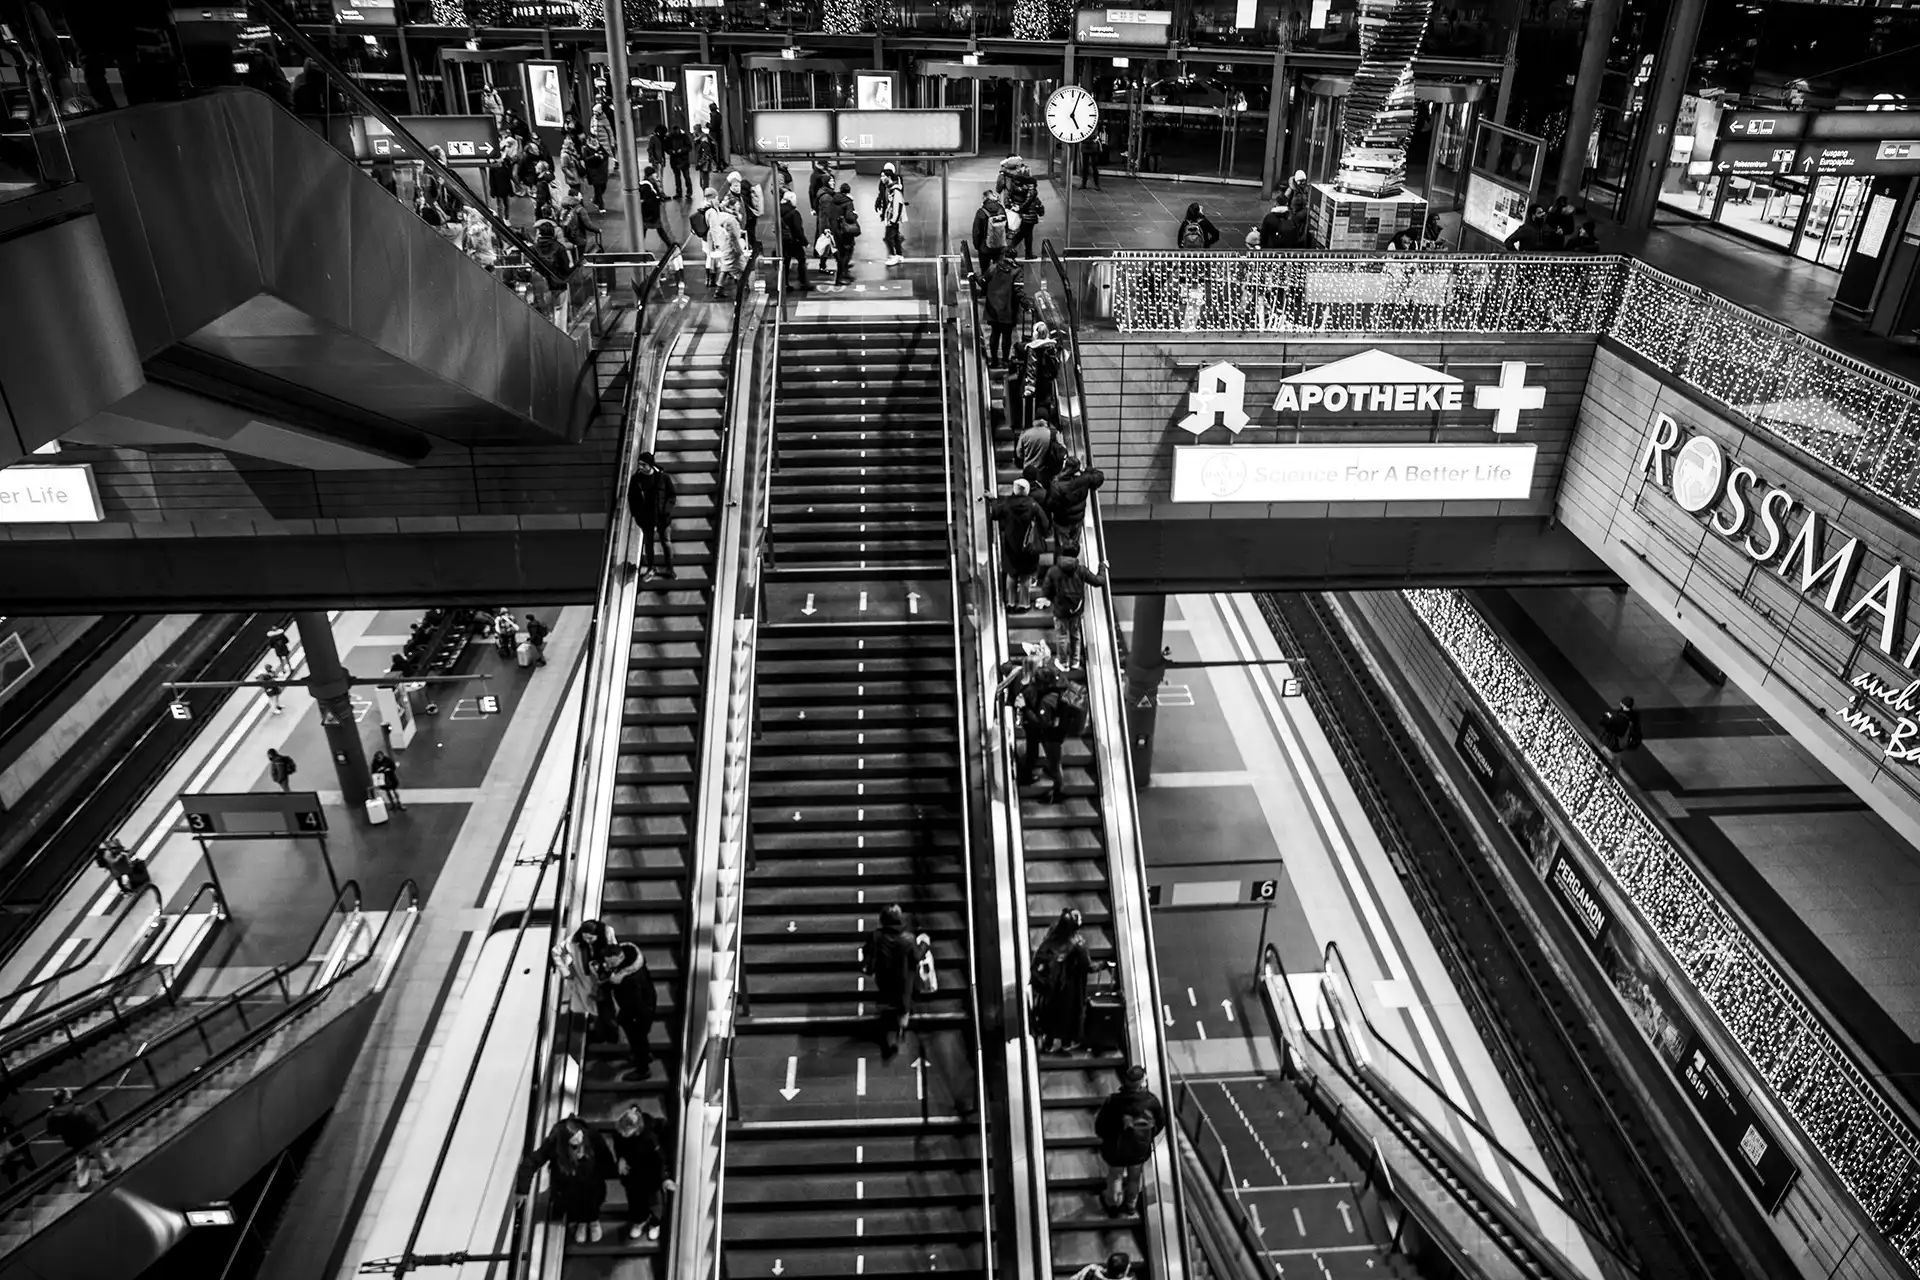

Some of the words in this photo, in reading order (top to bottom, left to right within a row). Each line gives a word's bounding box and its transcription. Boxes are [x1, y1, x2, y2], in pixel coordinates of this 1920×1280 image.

[1821, 148, 1849, 159] Ausgang
[1819, 157, 1856, 168] Europaplatz
[1272, 383, 1464, 412] APOTHEKE
[1254, 466, 1338, 483] Science
[1345, 465, 1379, 482] For
[1384, 465, 1399, 482] A
[1404, 464, 1469, 483] Better
[1475, 465, 1511, 482] Life
[26, 486, 68, 504] Life
[1284, 679, 1297, 696] E
[170, 704, 187, 719] E
[483, 696, 498, 711] E
[1836, 695, 1880, 737] im
[190, 813, 205, 829] 3
[305, 812, 317, 827] 4
[1260, 880, 1274, 898] 6
[1556, 857, 1605, 931] PERGAMON
